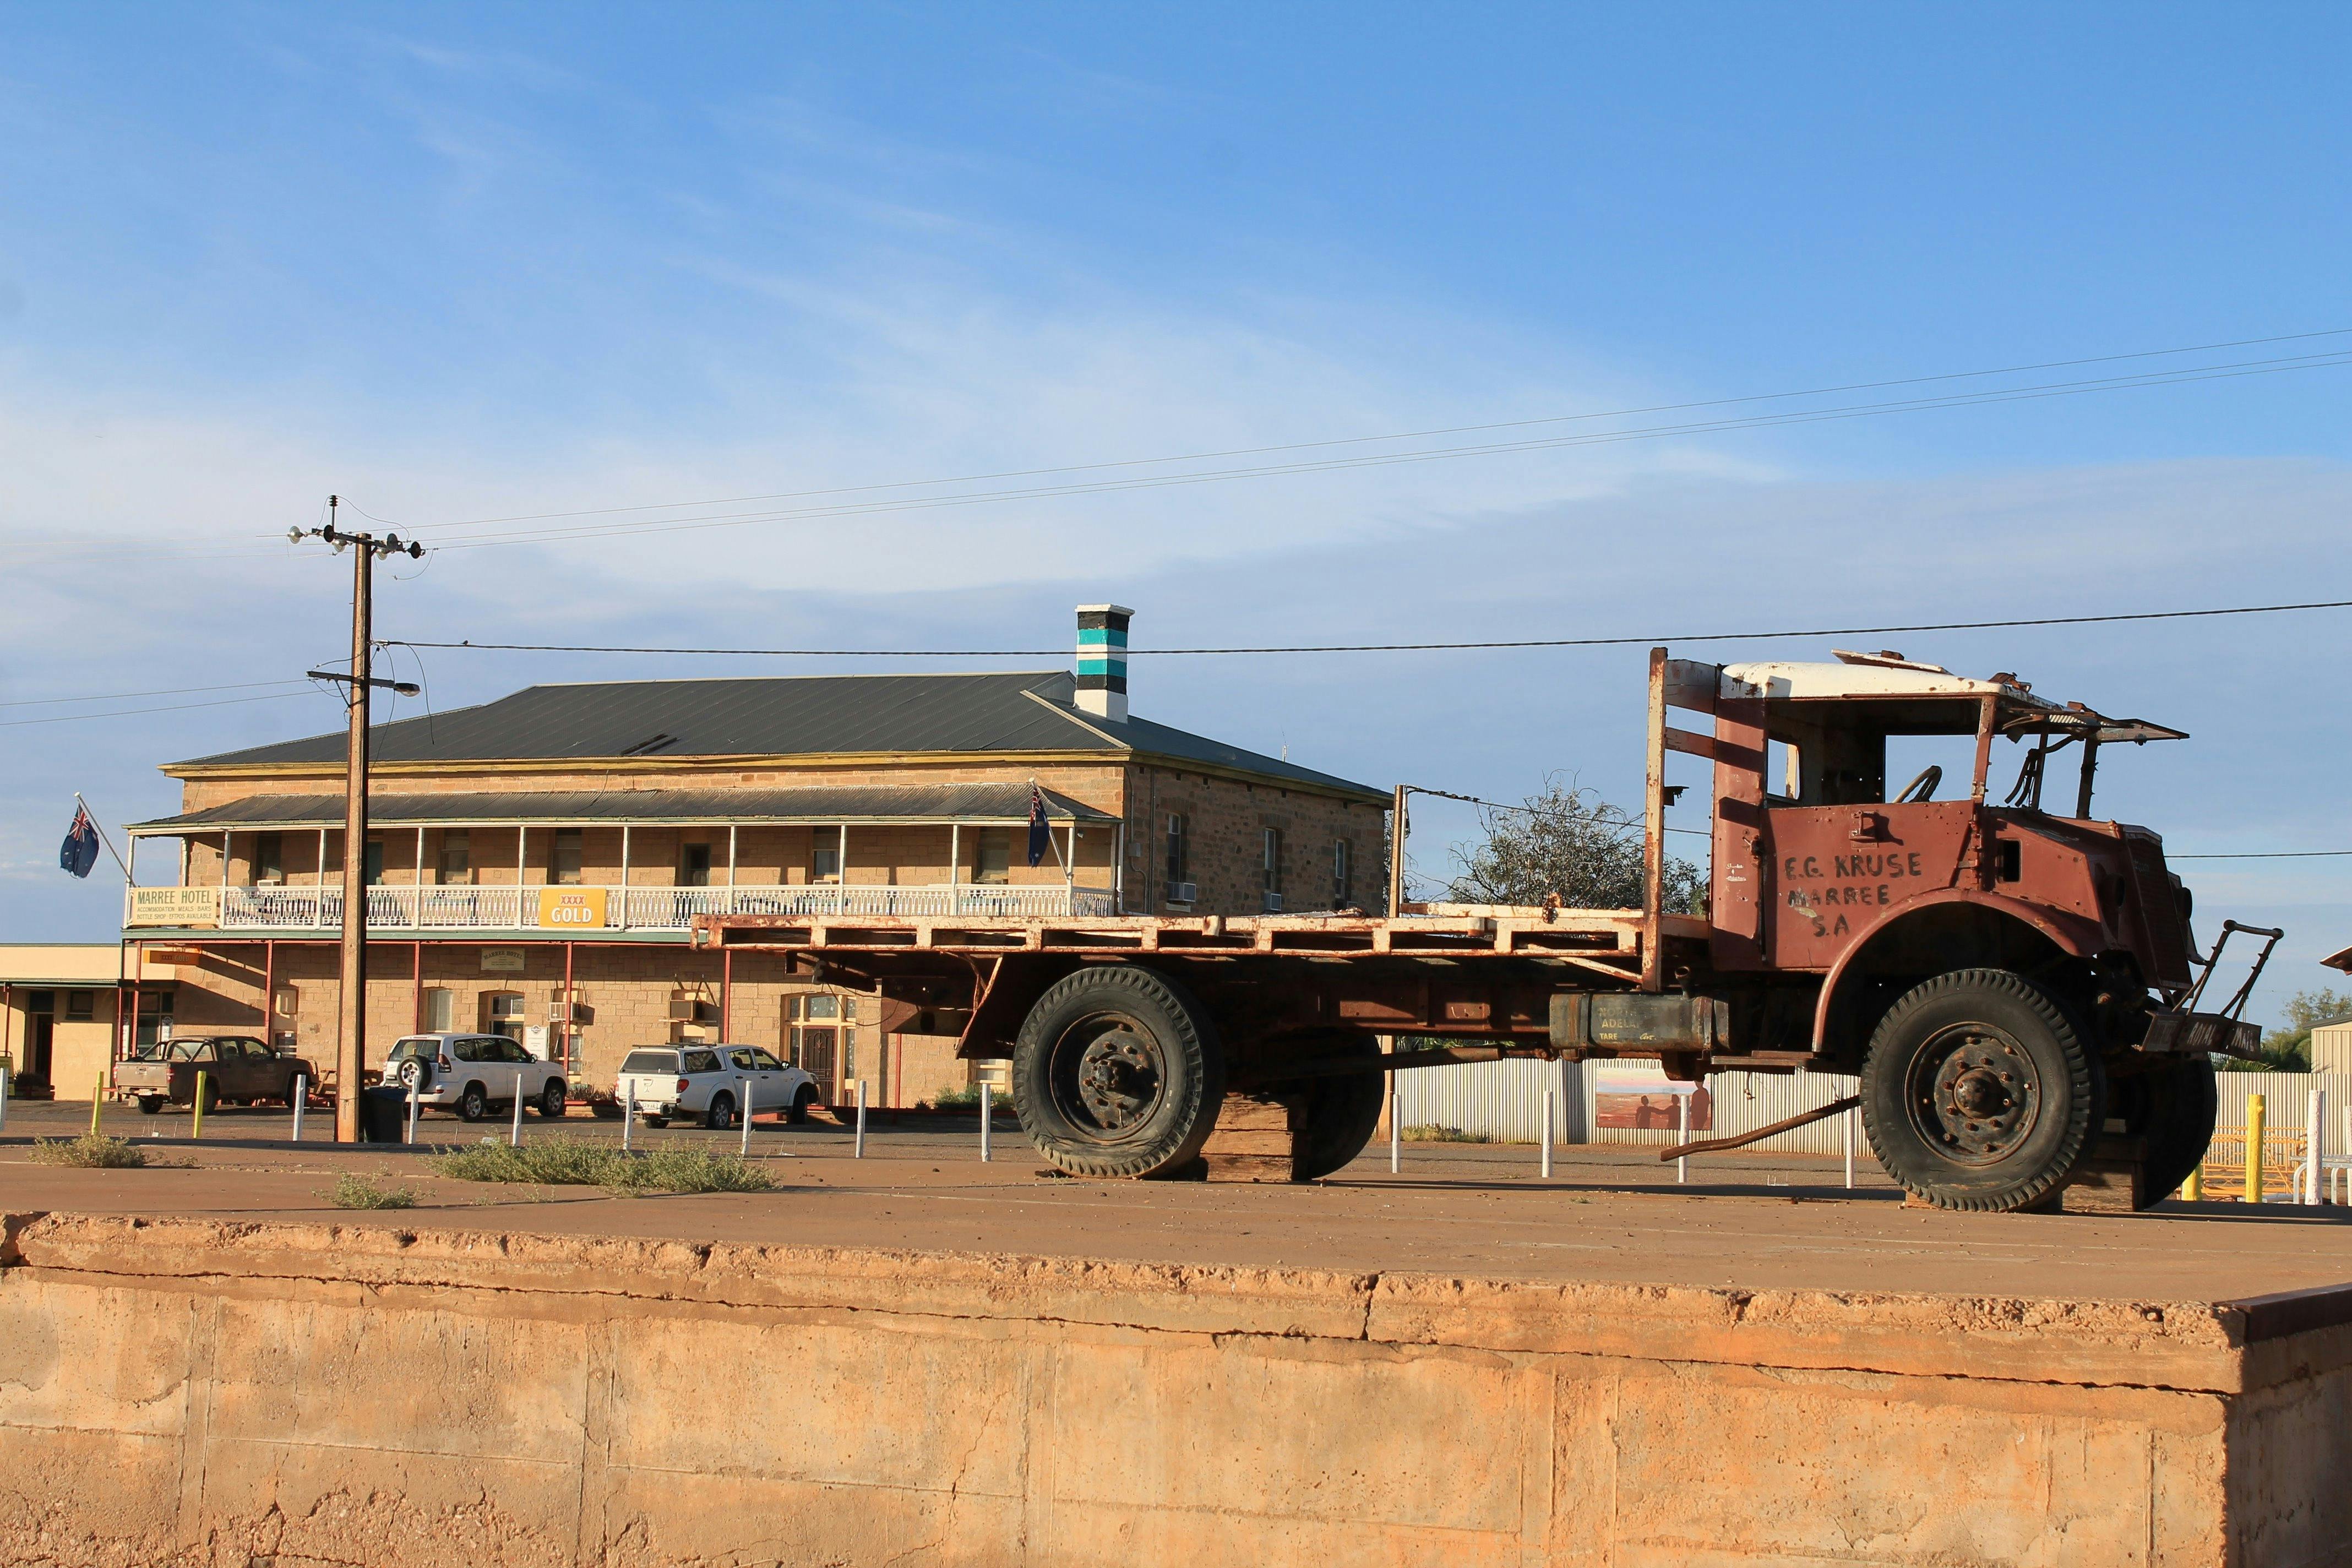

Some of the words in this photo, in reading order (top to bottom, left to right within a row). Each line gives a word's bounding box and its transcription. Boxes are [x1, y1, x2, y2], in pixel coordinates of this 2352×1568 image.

[1834, 852, 1921, 878] KRUSE
[138, 890, 176, 905] MARREE
[181, 890, 213, 904] HOTEL
[560, 895, 585, 905] XXXX
[1788, 884, 1890, 907] MARREE
[551, 907, 593, 923] GOLD
[483, 950, 505, 960] MARREE
[506, 950, 524, 960] HOTEL
[2186, 1021, 2217, 1046] ROYAL
